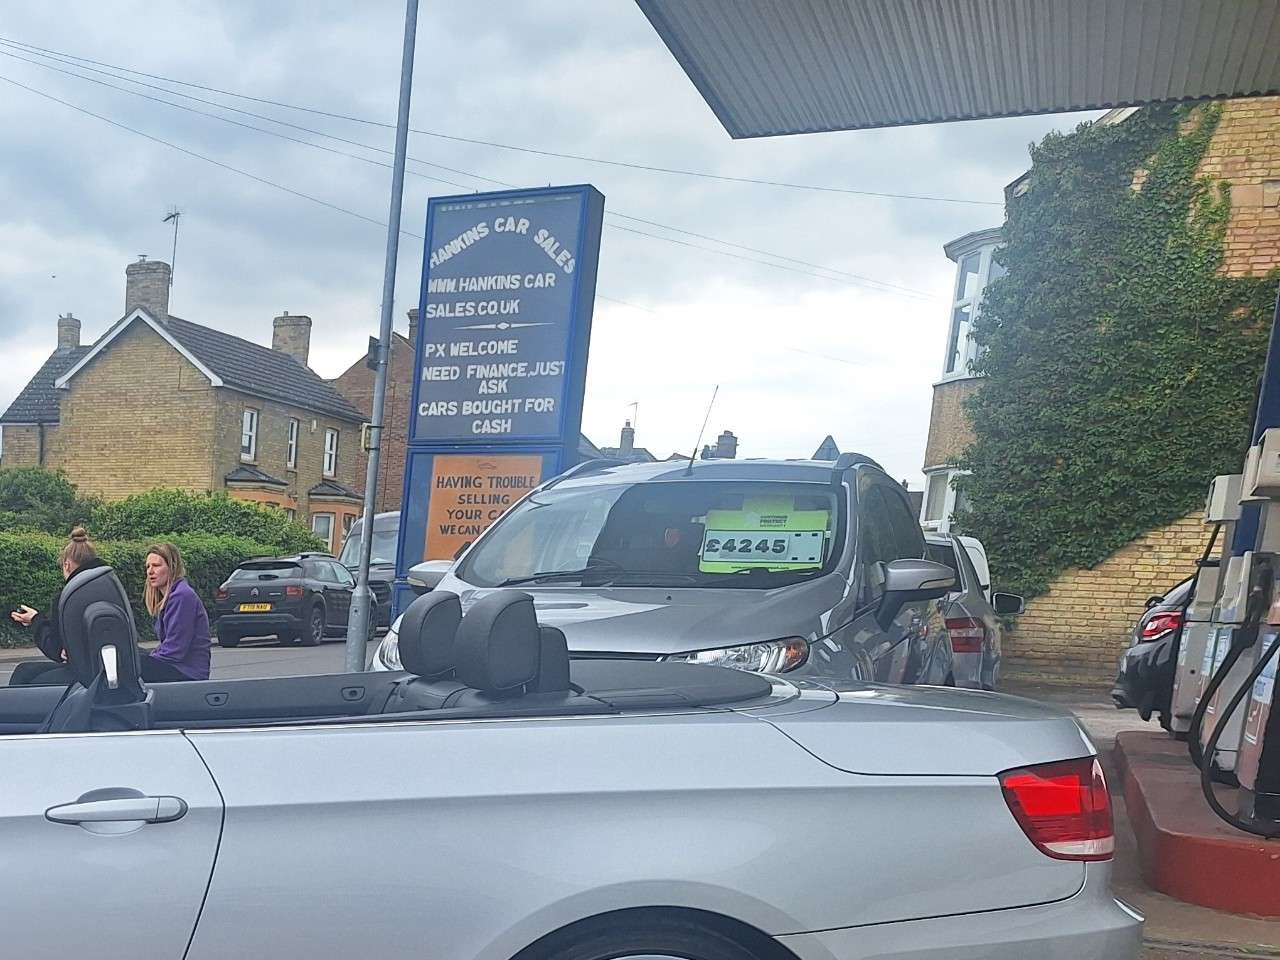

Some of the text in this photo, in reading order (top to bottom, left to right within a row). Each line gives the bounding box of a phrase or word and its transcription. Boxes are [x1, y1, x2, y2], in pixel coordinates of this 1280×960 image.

[429, 216, 576, 274] HANKINS CAR SALES
[524, 272, 556, 289] CAR
[426, 299, 520, 319] SALES.CO.UK
[425, 340, 519, 358] PX WELCOME
[422, 365, 460, 381] NEED
[478, 379, 508, 394] ASK
[418, 398, 555, 417] CARS BOUGHT FOR
[471, 419, 512, 434] CASH
[436, 476, 536, 489] HAVING TROUBLE
[457, 494, 510, 505] SELLING
[446, 508, 482, 520] YOUR
[705, 539, 786, 553] £4245
